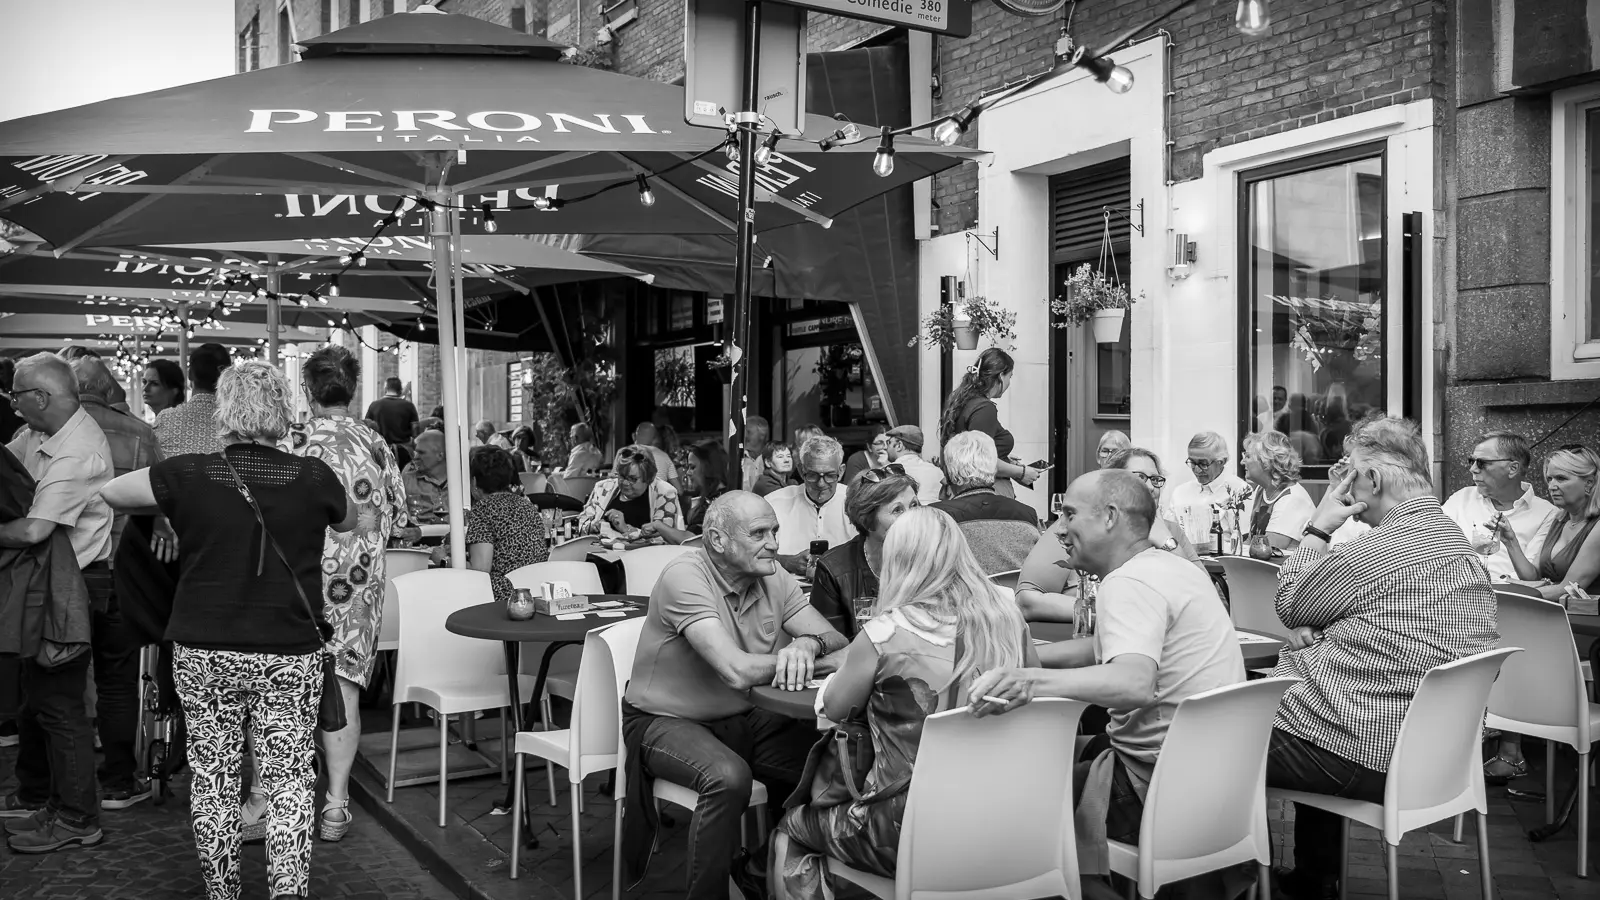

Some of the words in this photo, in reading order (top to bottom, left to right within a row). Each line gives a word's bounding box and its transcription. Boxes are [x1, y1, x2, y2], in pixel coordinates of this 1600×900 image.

[847, 0, 913, 14] omedie
[920, 0, 941, 12] 380
[917, 13, 941, 22] meter
[244, 109, 658, 134] PERONI
